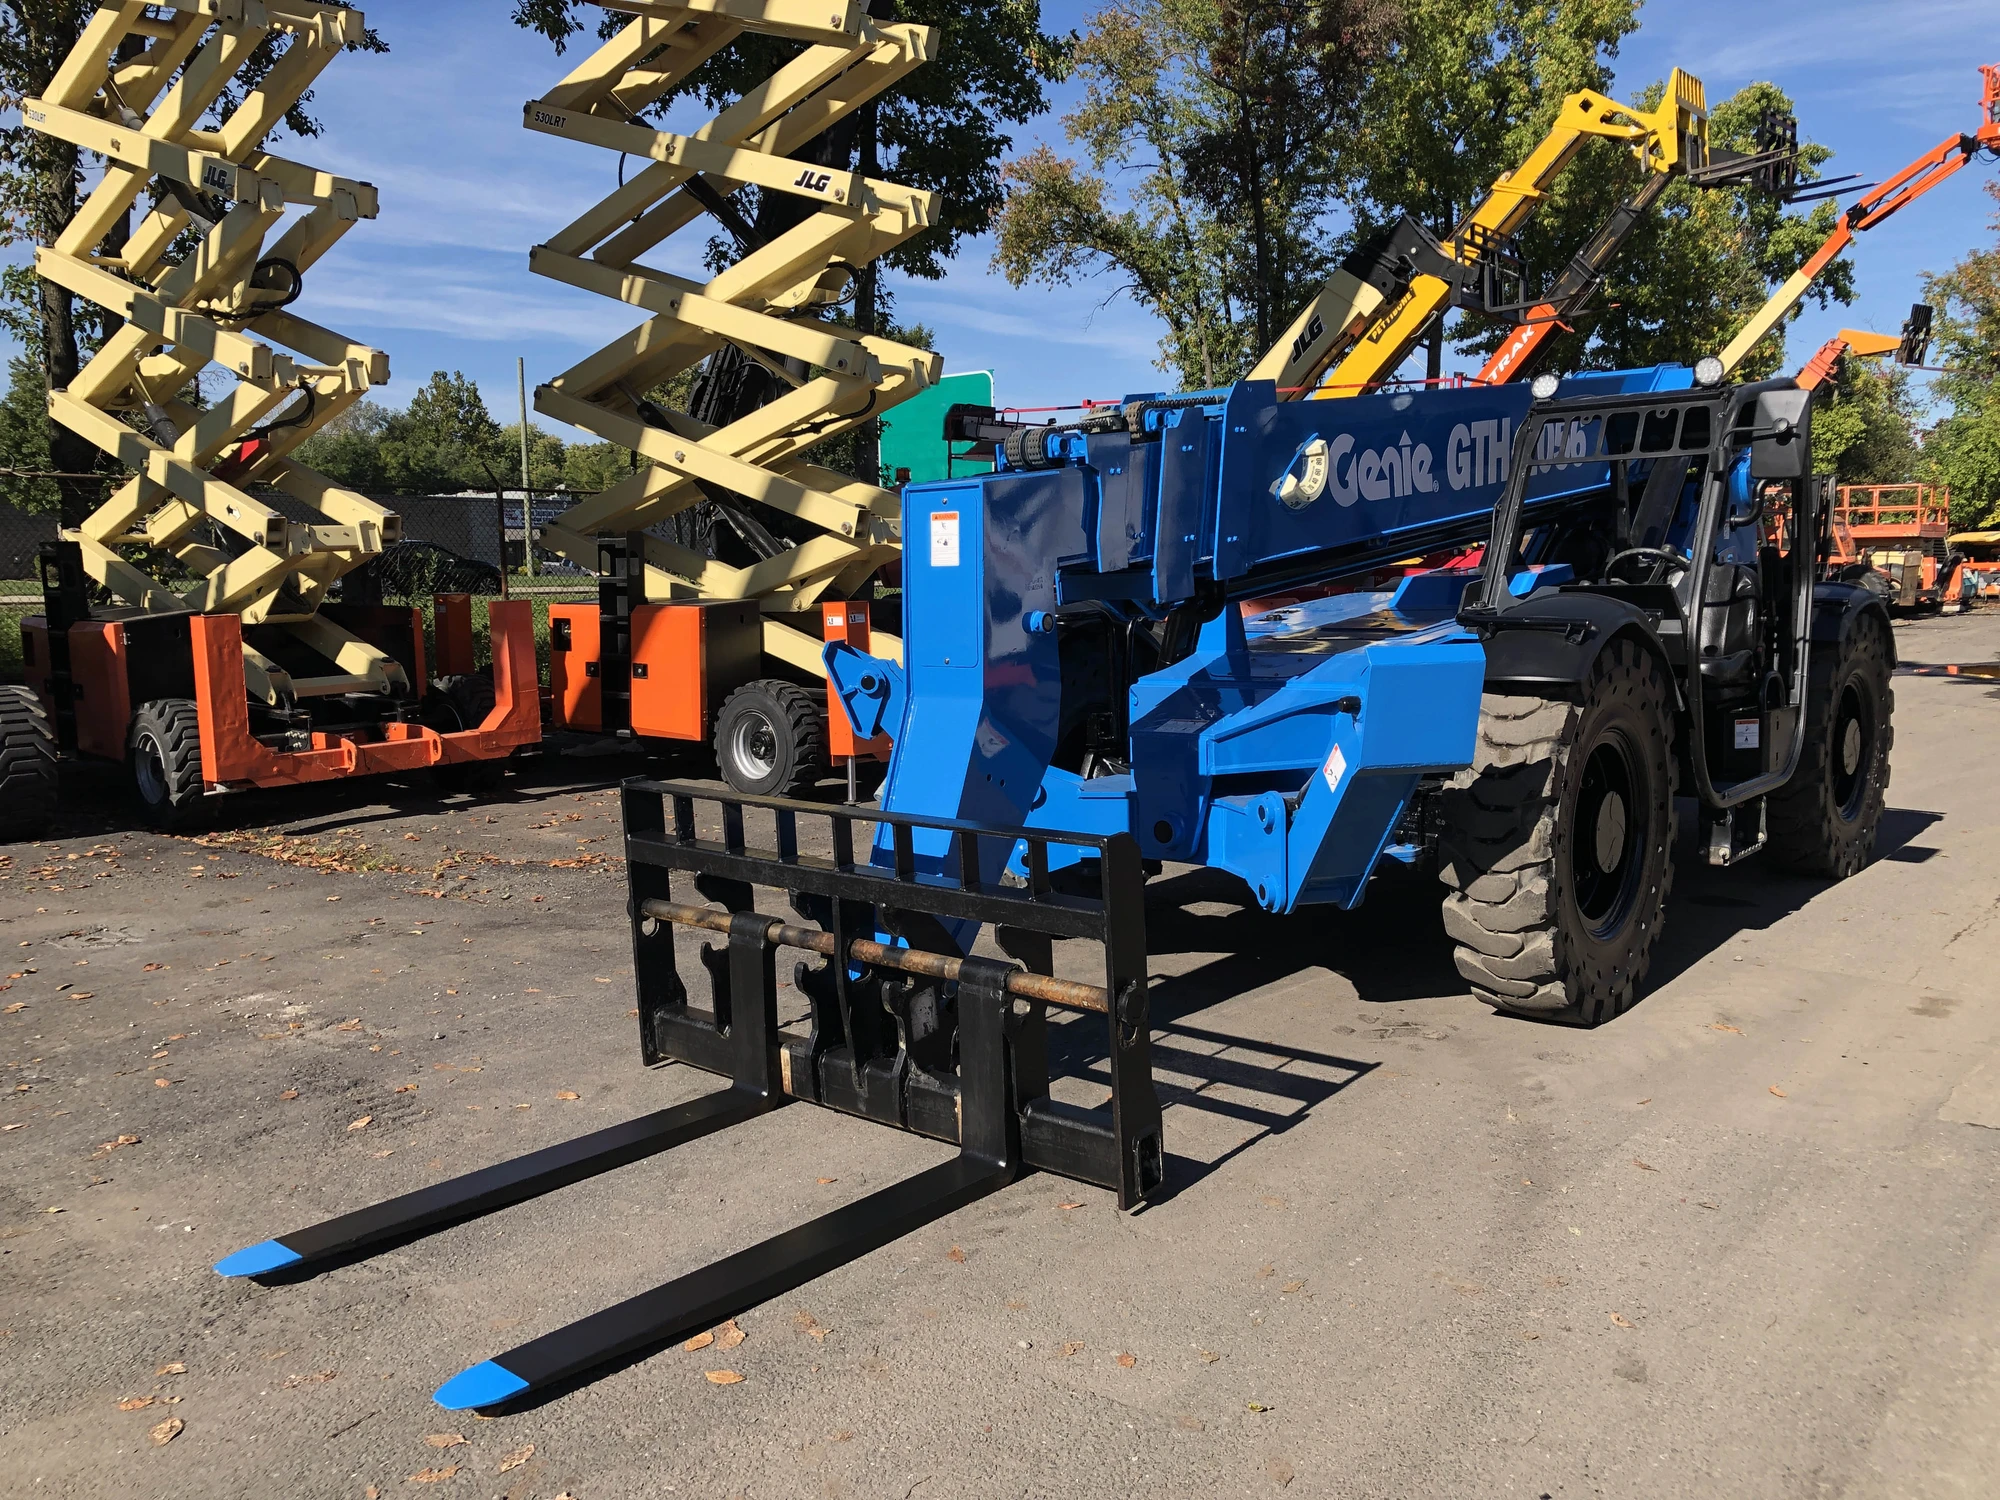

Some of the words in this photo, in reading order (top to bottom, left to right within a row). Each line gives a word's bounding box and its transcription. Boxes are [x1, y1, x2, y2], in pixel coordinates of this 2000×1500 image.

[535, 111, 567, 128] 530LRT
[203, 164, 228, 190] JLG
[793, 169, 832, 193] JLG
[1292, 313, 1324, 365] JLG
